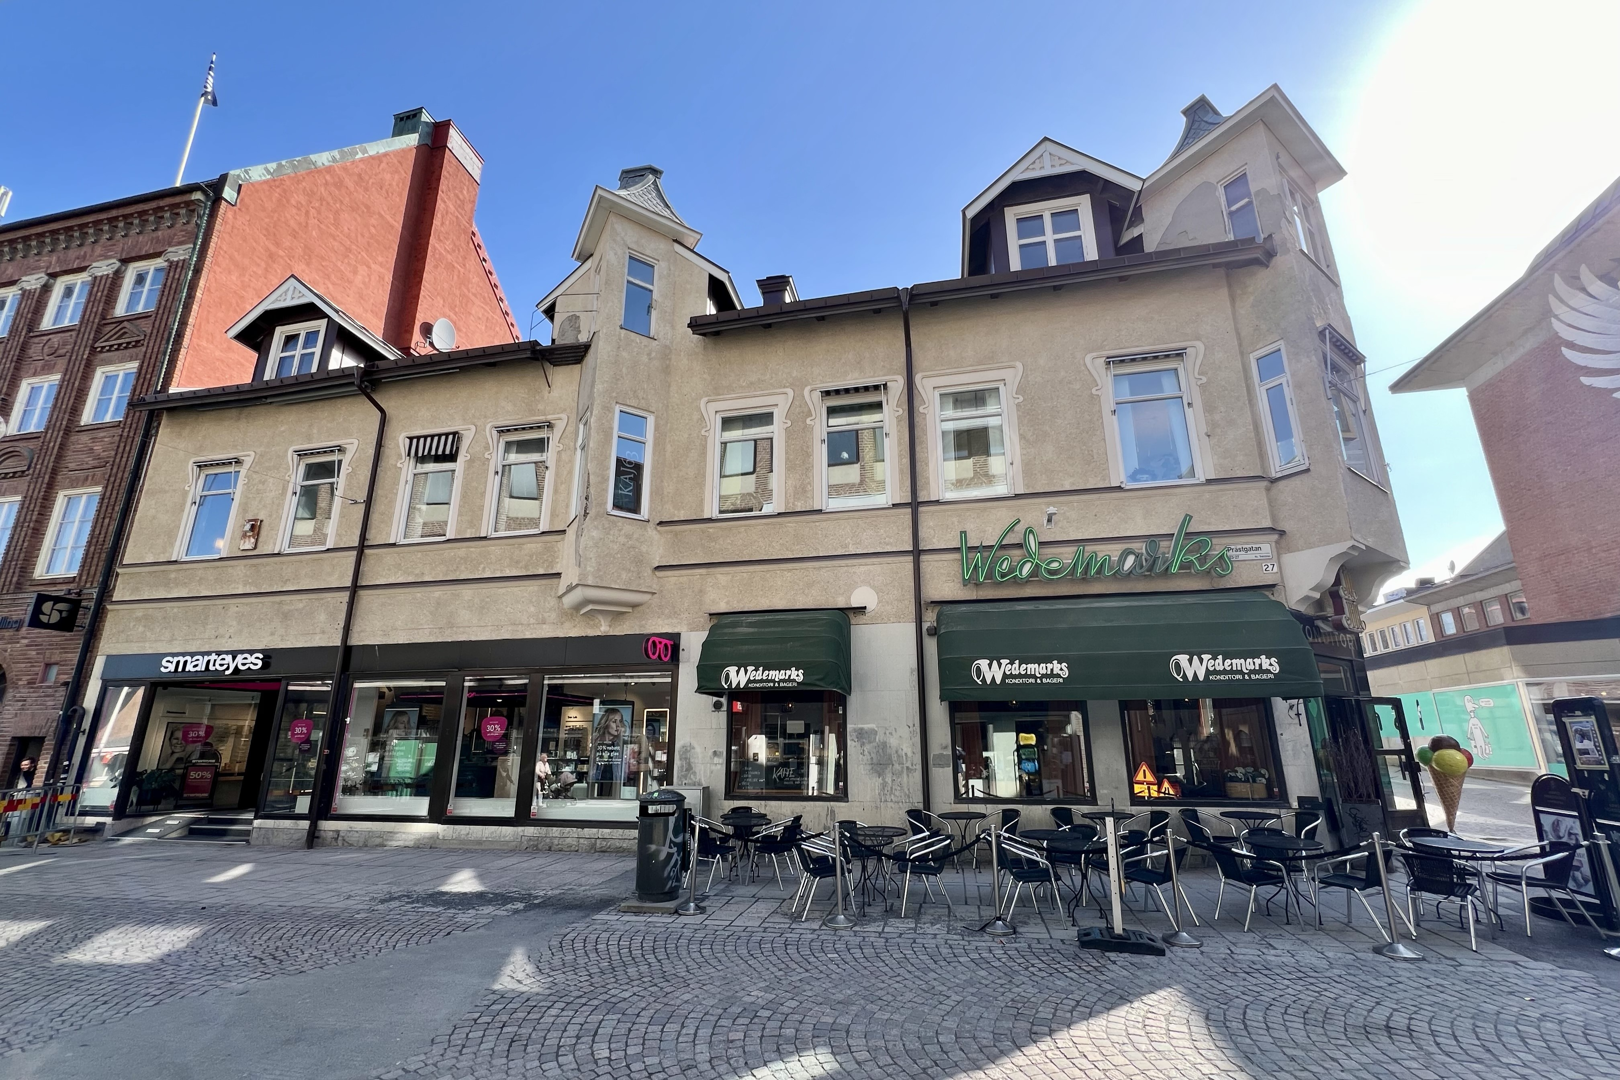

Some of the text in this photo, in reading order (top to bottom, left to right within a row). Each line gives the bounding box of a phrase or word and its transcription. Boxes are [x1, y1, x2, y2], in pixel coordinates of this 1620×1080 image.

[960, 513, 1233, 586] Wedemarks
[1227, 545, 1262, 554] Prästgatan
[1263, 563, 1276, 572] 27
[160, 653, 264, 675] smarteyes
[971, 659, 1069, 685] Wedemarks
[1169, 654, 1280, 682] Wedemarks
[721, 666, 804, 689] Wedemarks
